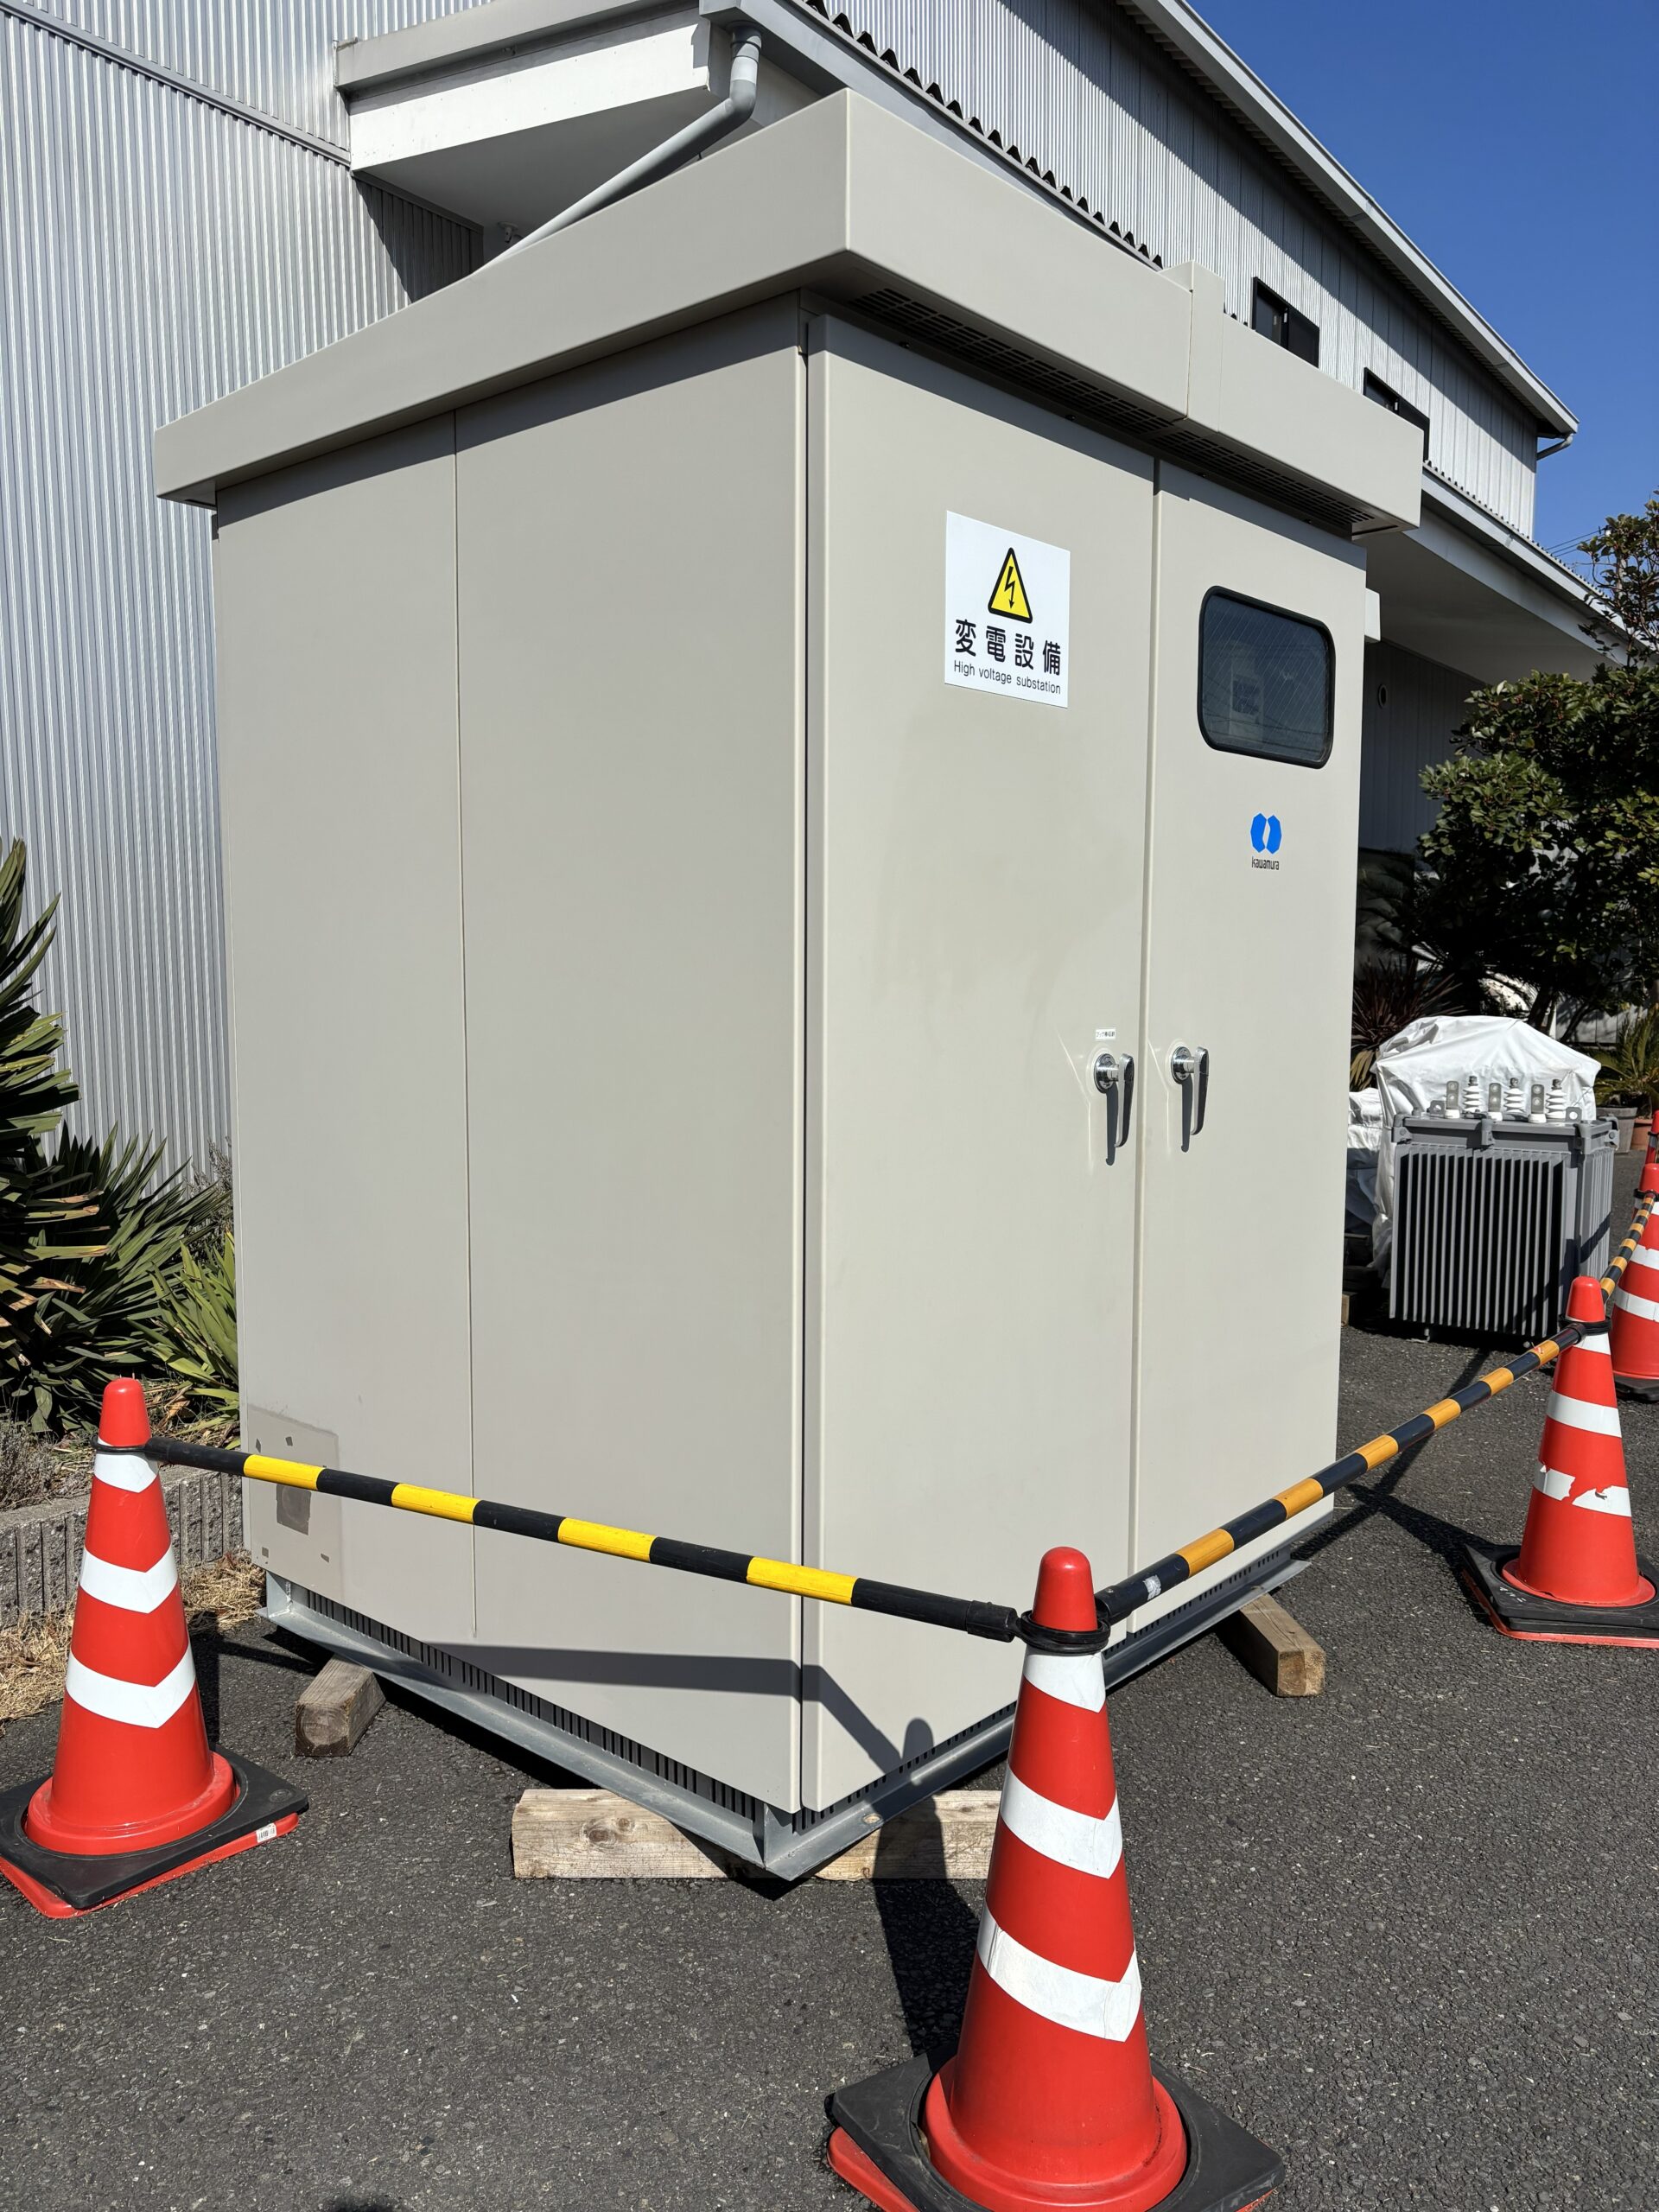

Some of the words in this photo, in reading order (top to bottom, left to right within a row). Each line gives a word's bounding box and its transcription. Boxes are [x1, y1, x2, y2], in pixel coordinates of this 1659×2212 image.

[955, 619, 1061, 676] 変電設備
[954, 660, 976, 677] High
[979, 668, 1012, 684] voltage
[1016, 677, 1061, 694] substation
